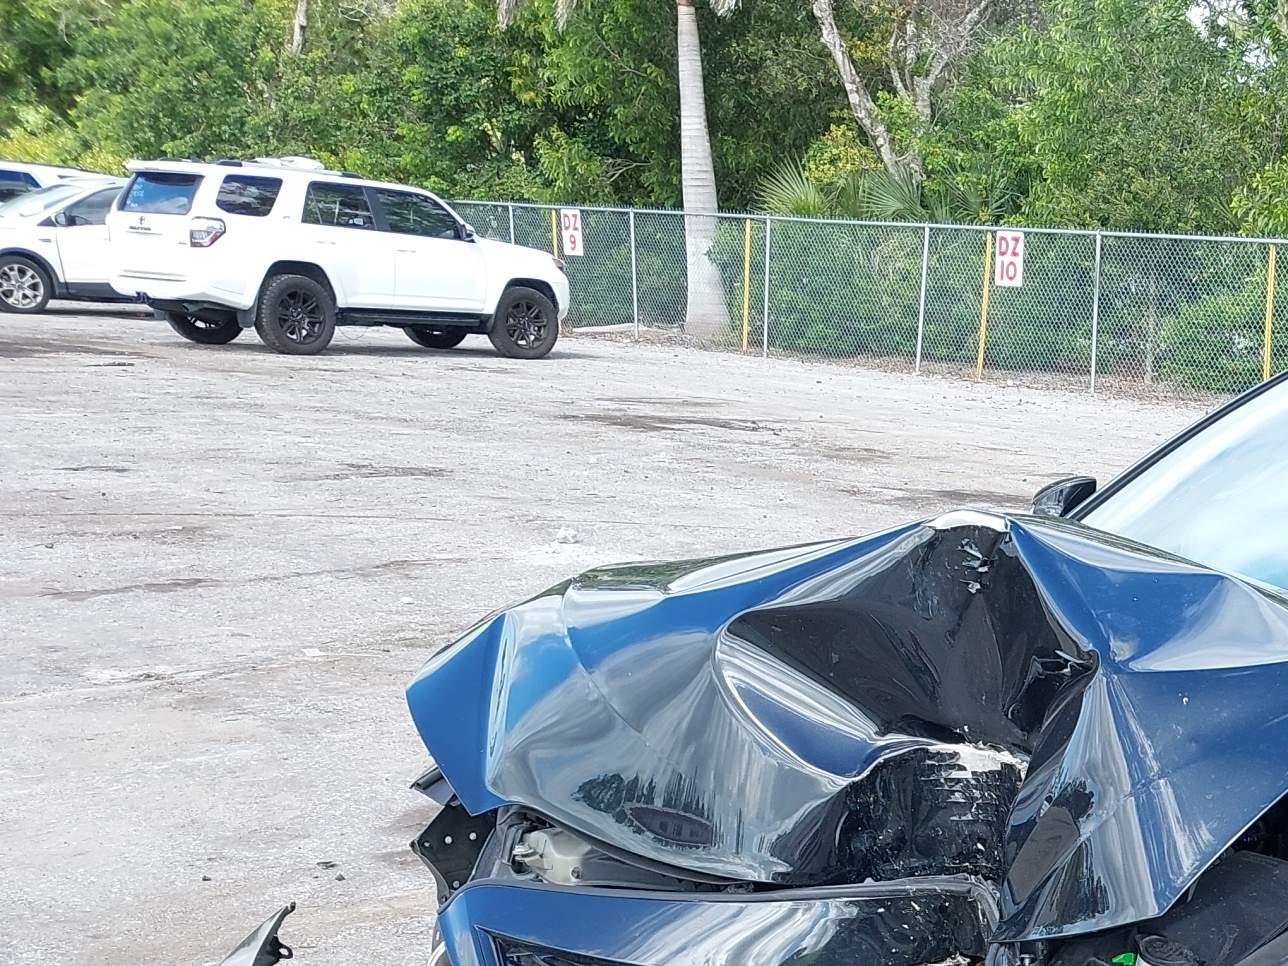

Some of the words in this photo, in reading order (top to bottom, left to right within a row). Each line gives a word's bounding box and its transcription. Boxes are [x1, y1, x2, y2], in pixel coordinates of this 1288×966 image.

[562, 213, 579, 232] DZ
[569, 233, 577, 251] 9
[998, 235, 1021, 257] DZ
[1000, 260, 1017, 281] 10
